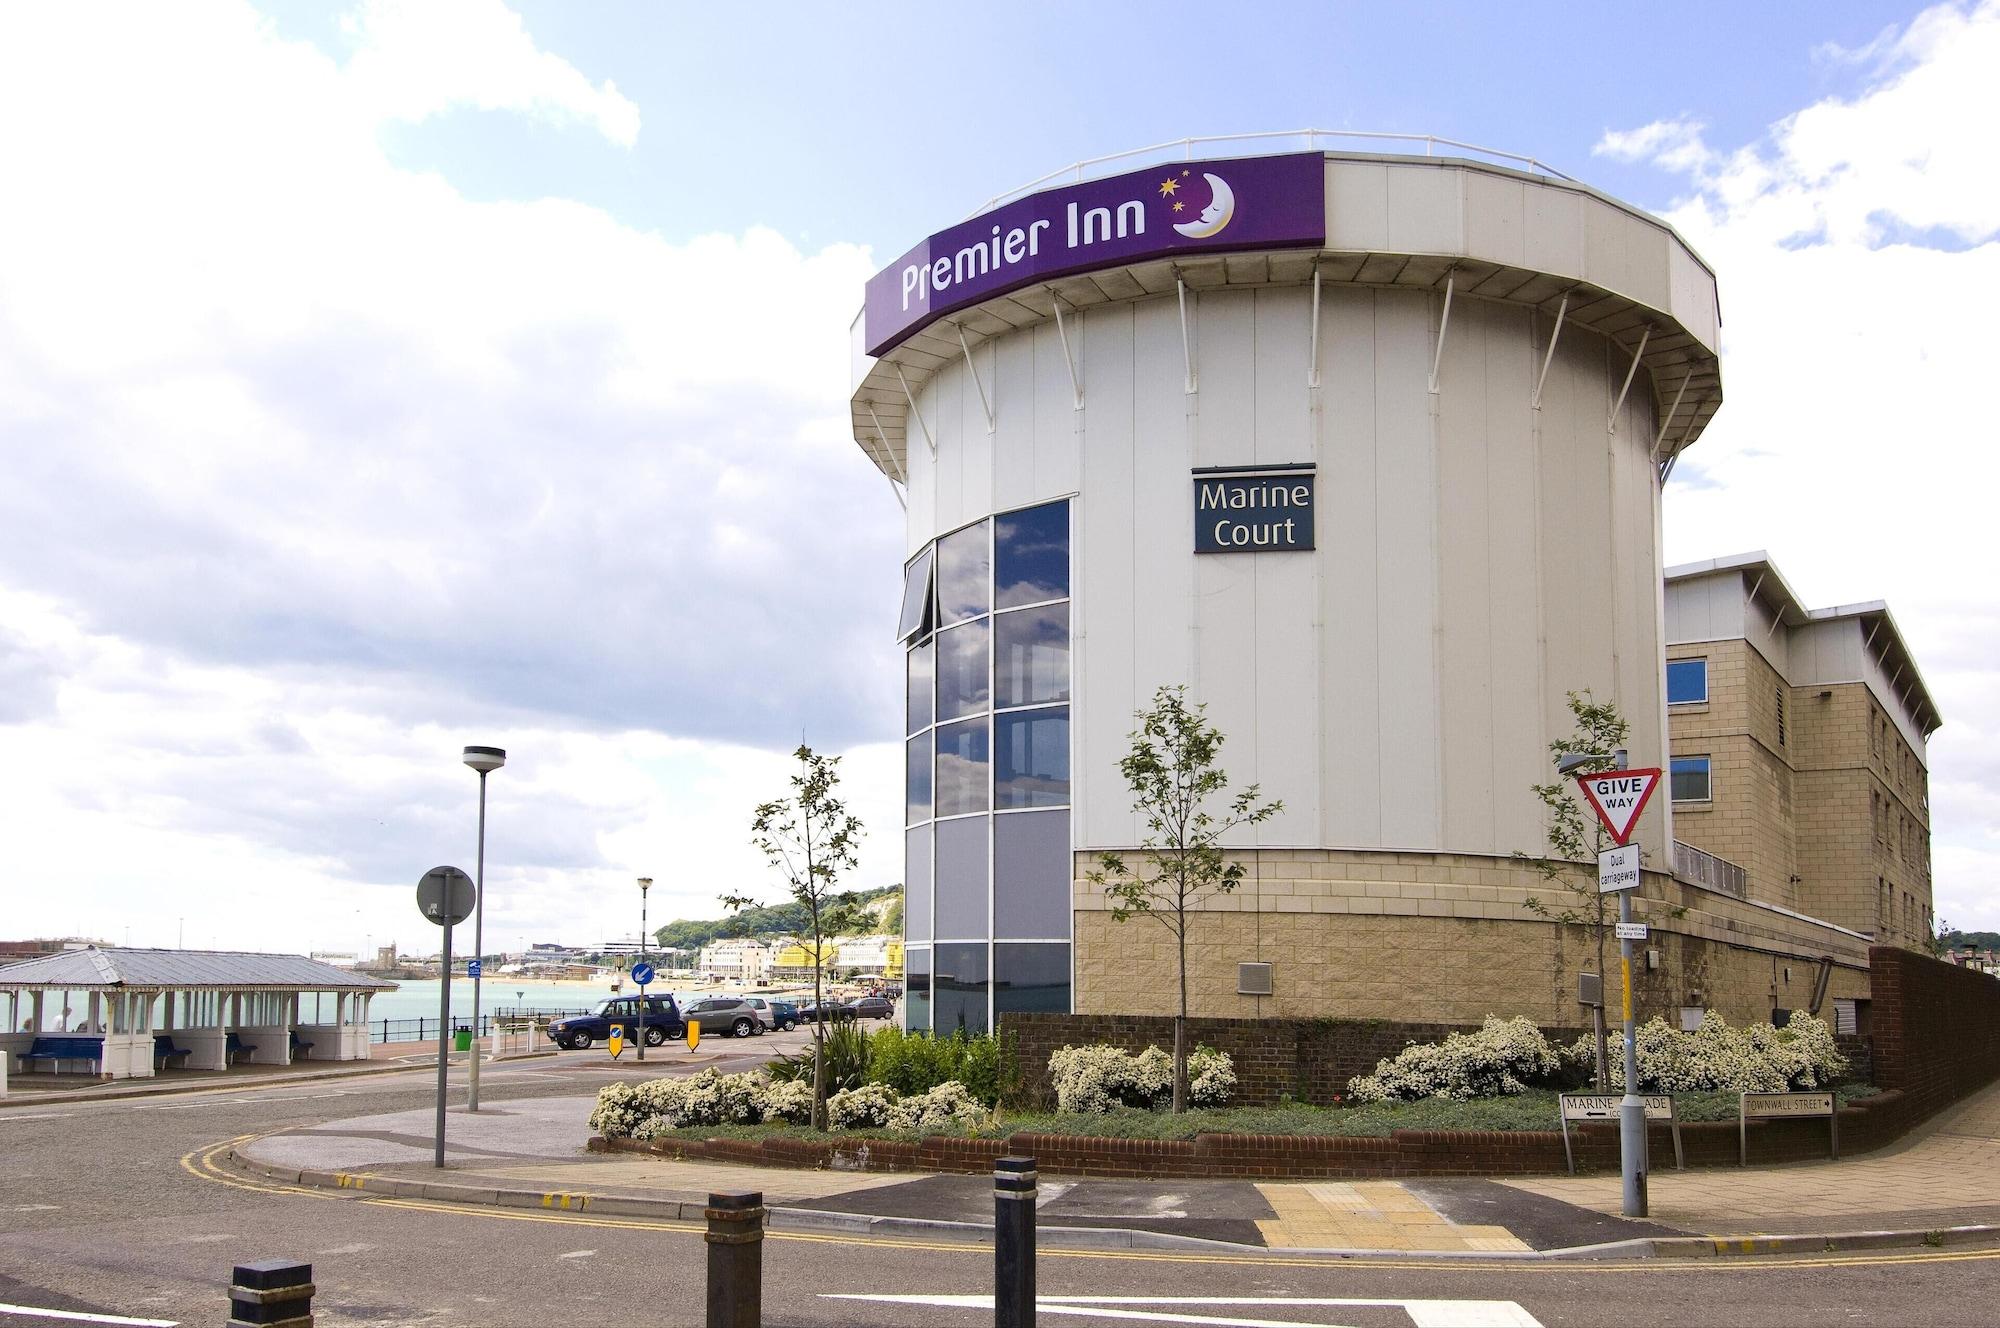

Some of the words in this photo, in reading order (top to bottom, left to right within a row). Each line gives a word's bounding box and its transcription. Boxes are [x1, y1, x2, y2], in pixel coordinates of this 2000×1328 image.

[902, 219, 1050, 312] Premier
[1067, 200, 1145, 249] Inn
[1200, 481, 1310, 510] Marine
[1214, 518, 1296, 546] Court
[1597, 778, 1642, 795] GIVE
[1605, 797, 1634, 809] WAY
[1610, 853, 1625, 867] Dual
[1600, 869, 1637, 885] carriageway
[1567, 1097, 1614, 1109] MARINE
[1746, 1099, 1791, 1111] TOWNWALL
[1794, 1099, 1822, 1110] STREET
